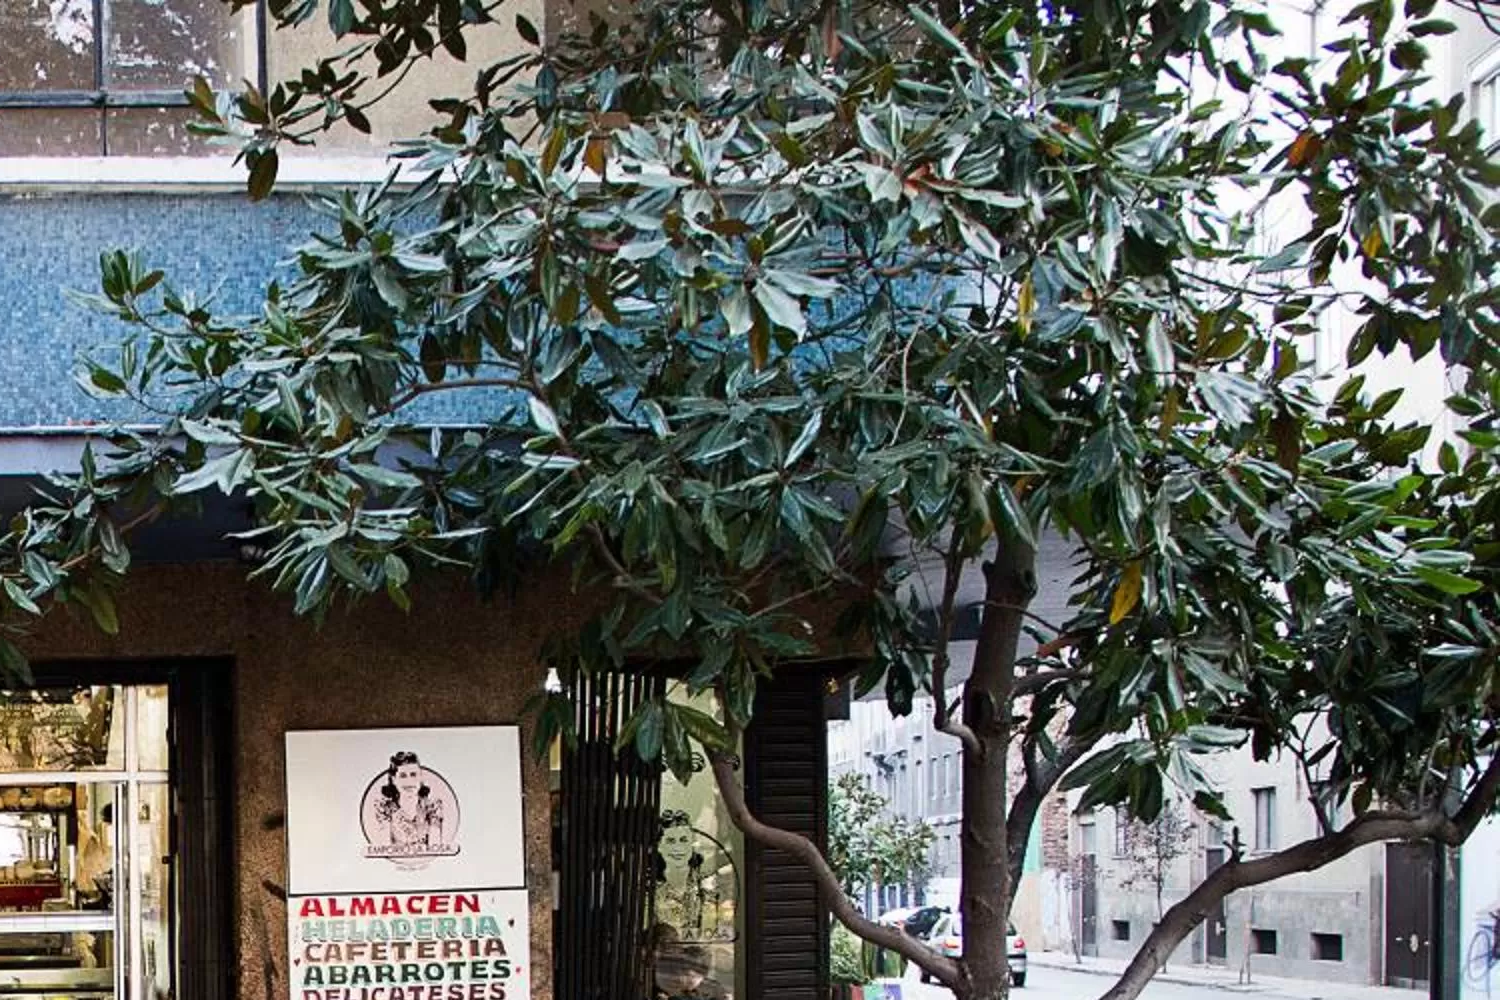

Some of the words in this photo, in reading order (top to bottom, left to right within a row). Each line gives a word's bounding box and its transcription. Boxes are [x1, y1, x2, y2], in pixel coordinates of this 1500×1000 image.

[299, 894, 481, 917] ALMACEN
[301, 915, 501, 942] HELADERIA
[304, 938, 507, 962] CAFETERIA
[303, 959, 511, 985] ABARROTES
